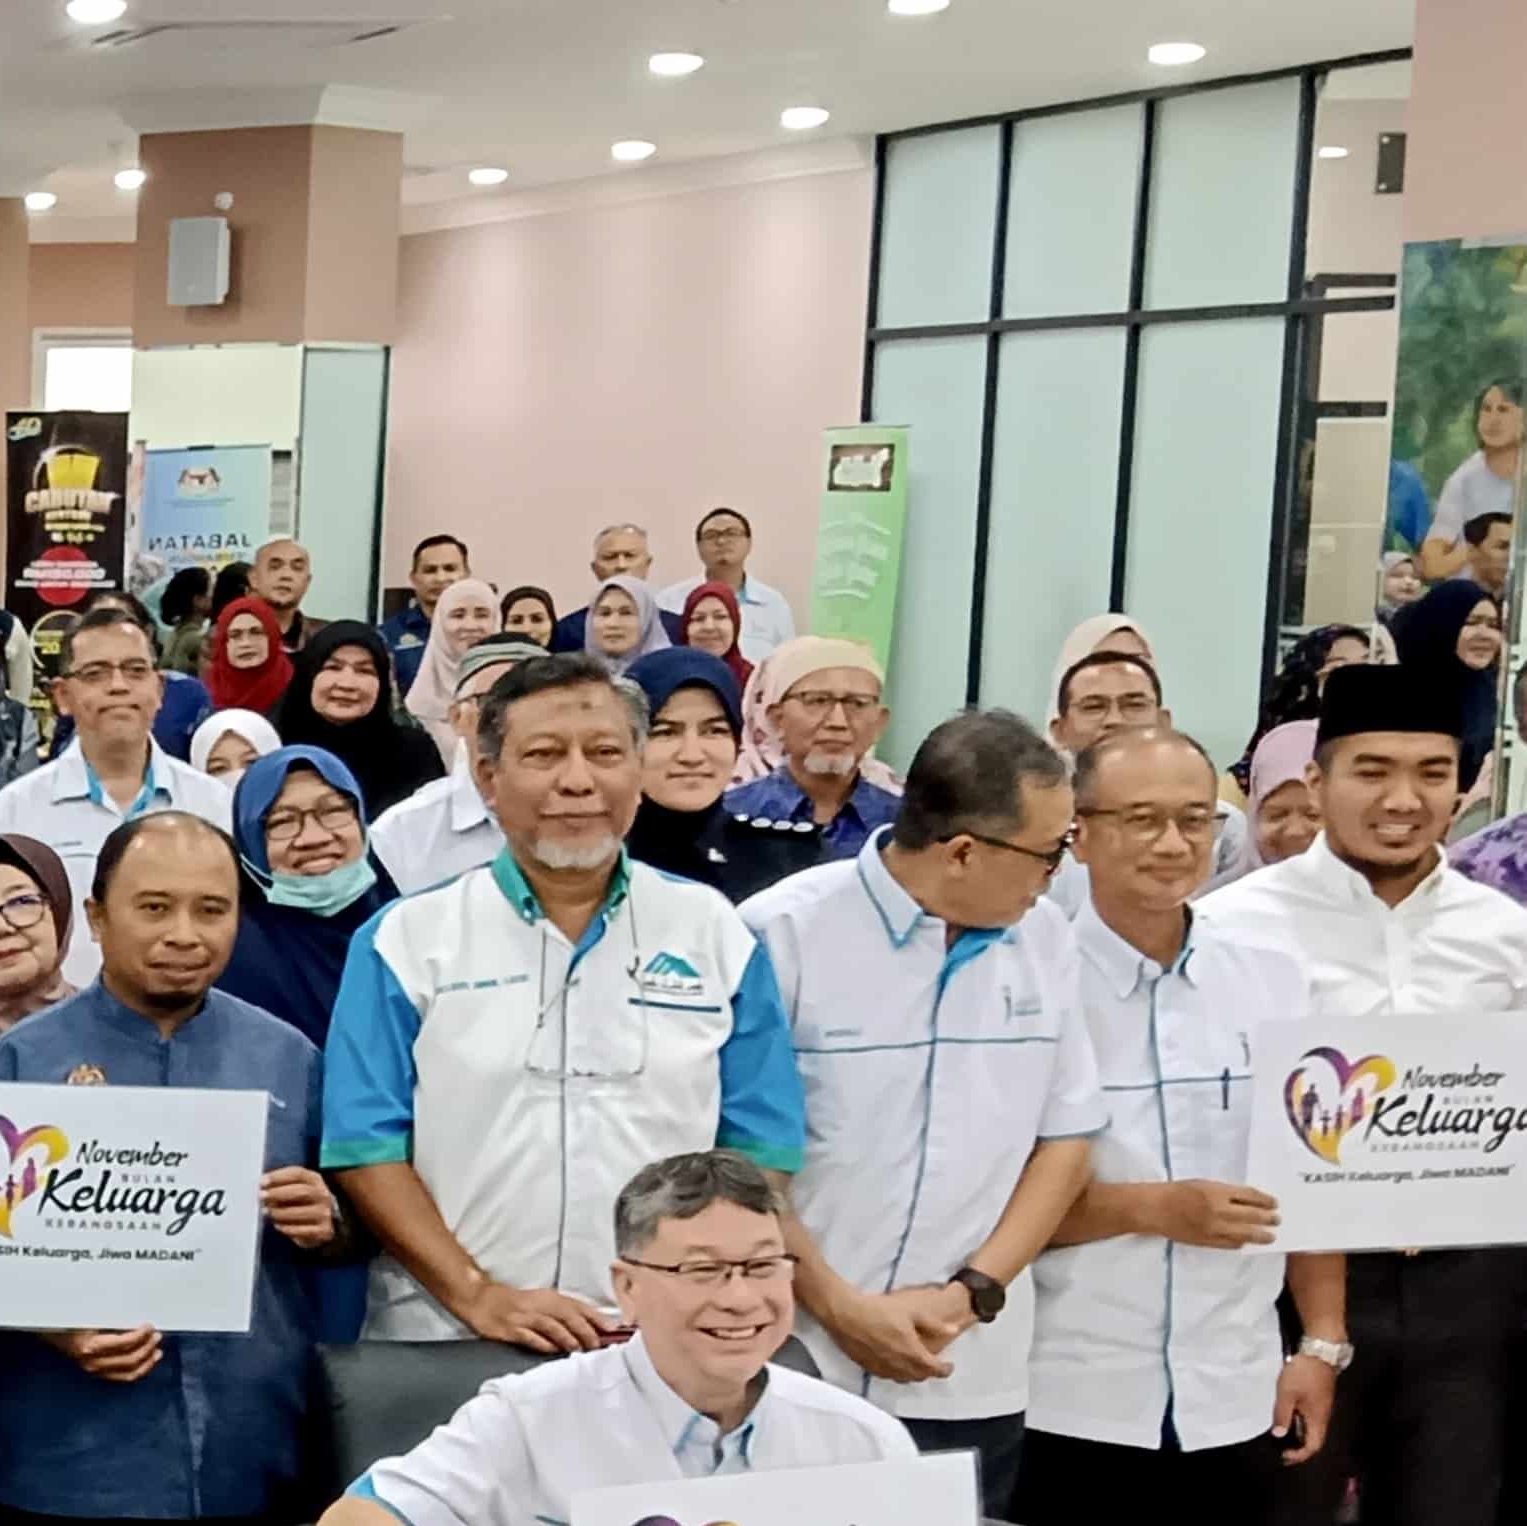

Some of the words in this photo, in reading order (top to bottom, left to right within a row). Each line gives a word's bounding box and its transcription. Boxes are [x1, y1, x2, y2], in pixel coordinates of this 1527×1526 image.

[77, 1140, 188, 1168] November
[121, 1174, 176, 1184] BULAN
[38, 1168, 226, 1236] Keluarga
[46, 1218, 161, 1231] KEBANGSAAN
[22, 1246, 94, 1261] Keluarga,
[98, 1249, 131, 1260] Jiwa
